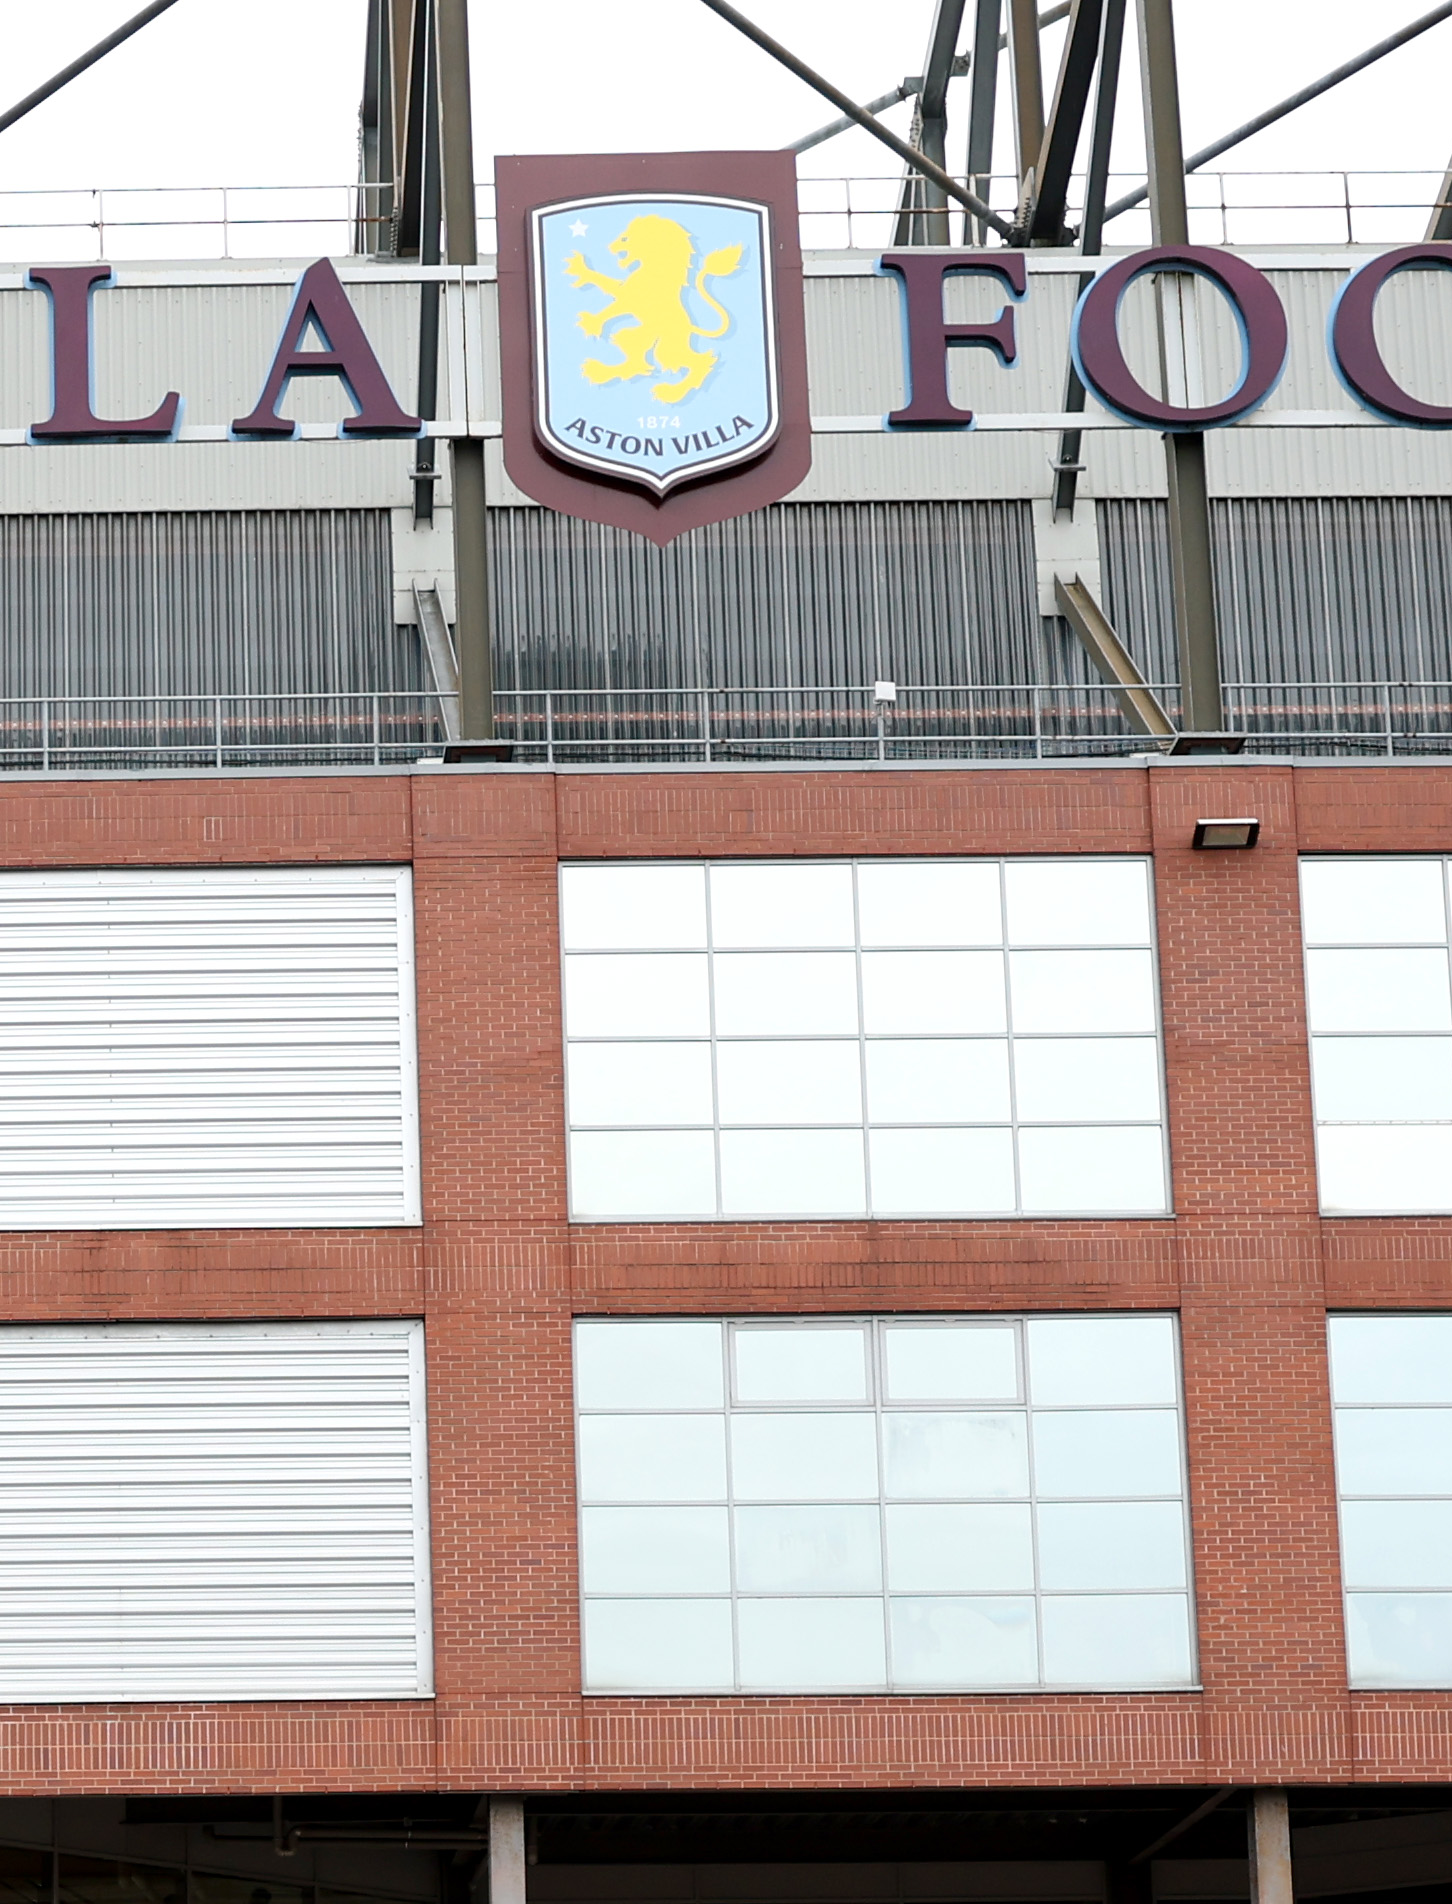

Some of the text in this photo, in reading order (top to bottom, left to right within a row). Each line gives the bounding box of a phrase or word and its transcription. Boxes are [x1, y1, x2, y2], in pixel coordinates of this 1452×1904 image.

[564, 414, 754, 457] ASTON VILLA
[637, 416, 680, 429] 1874
